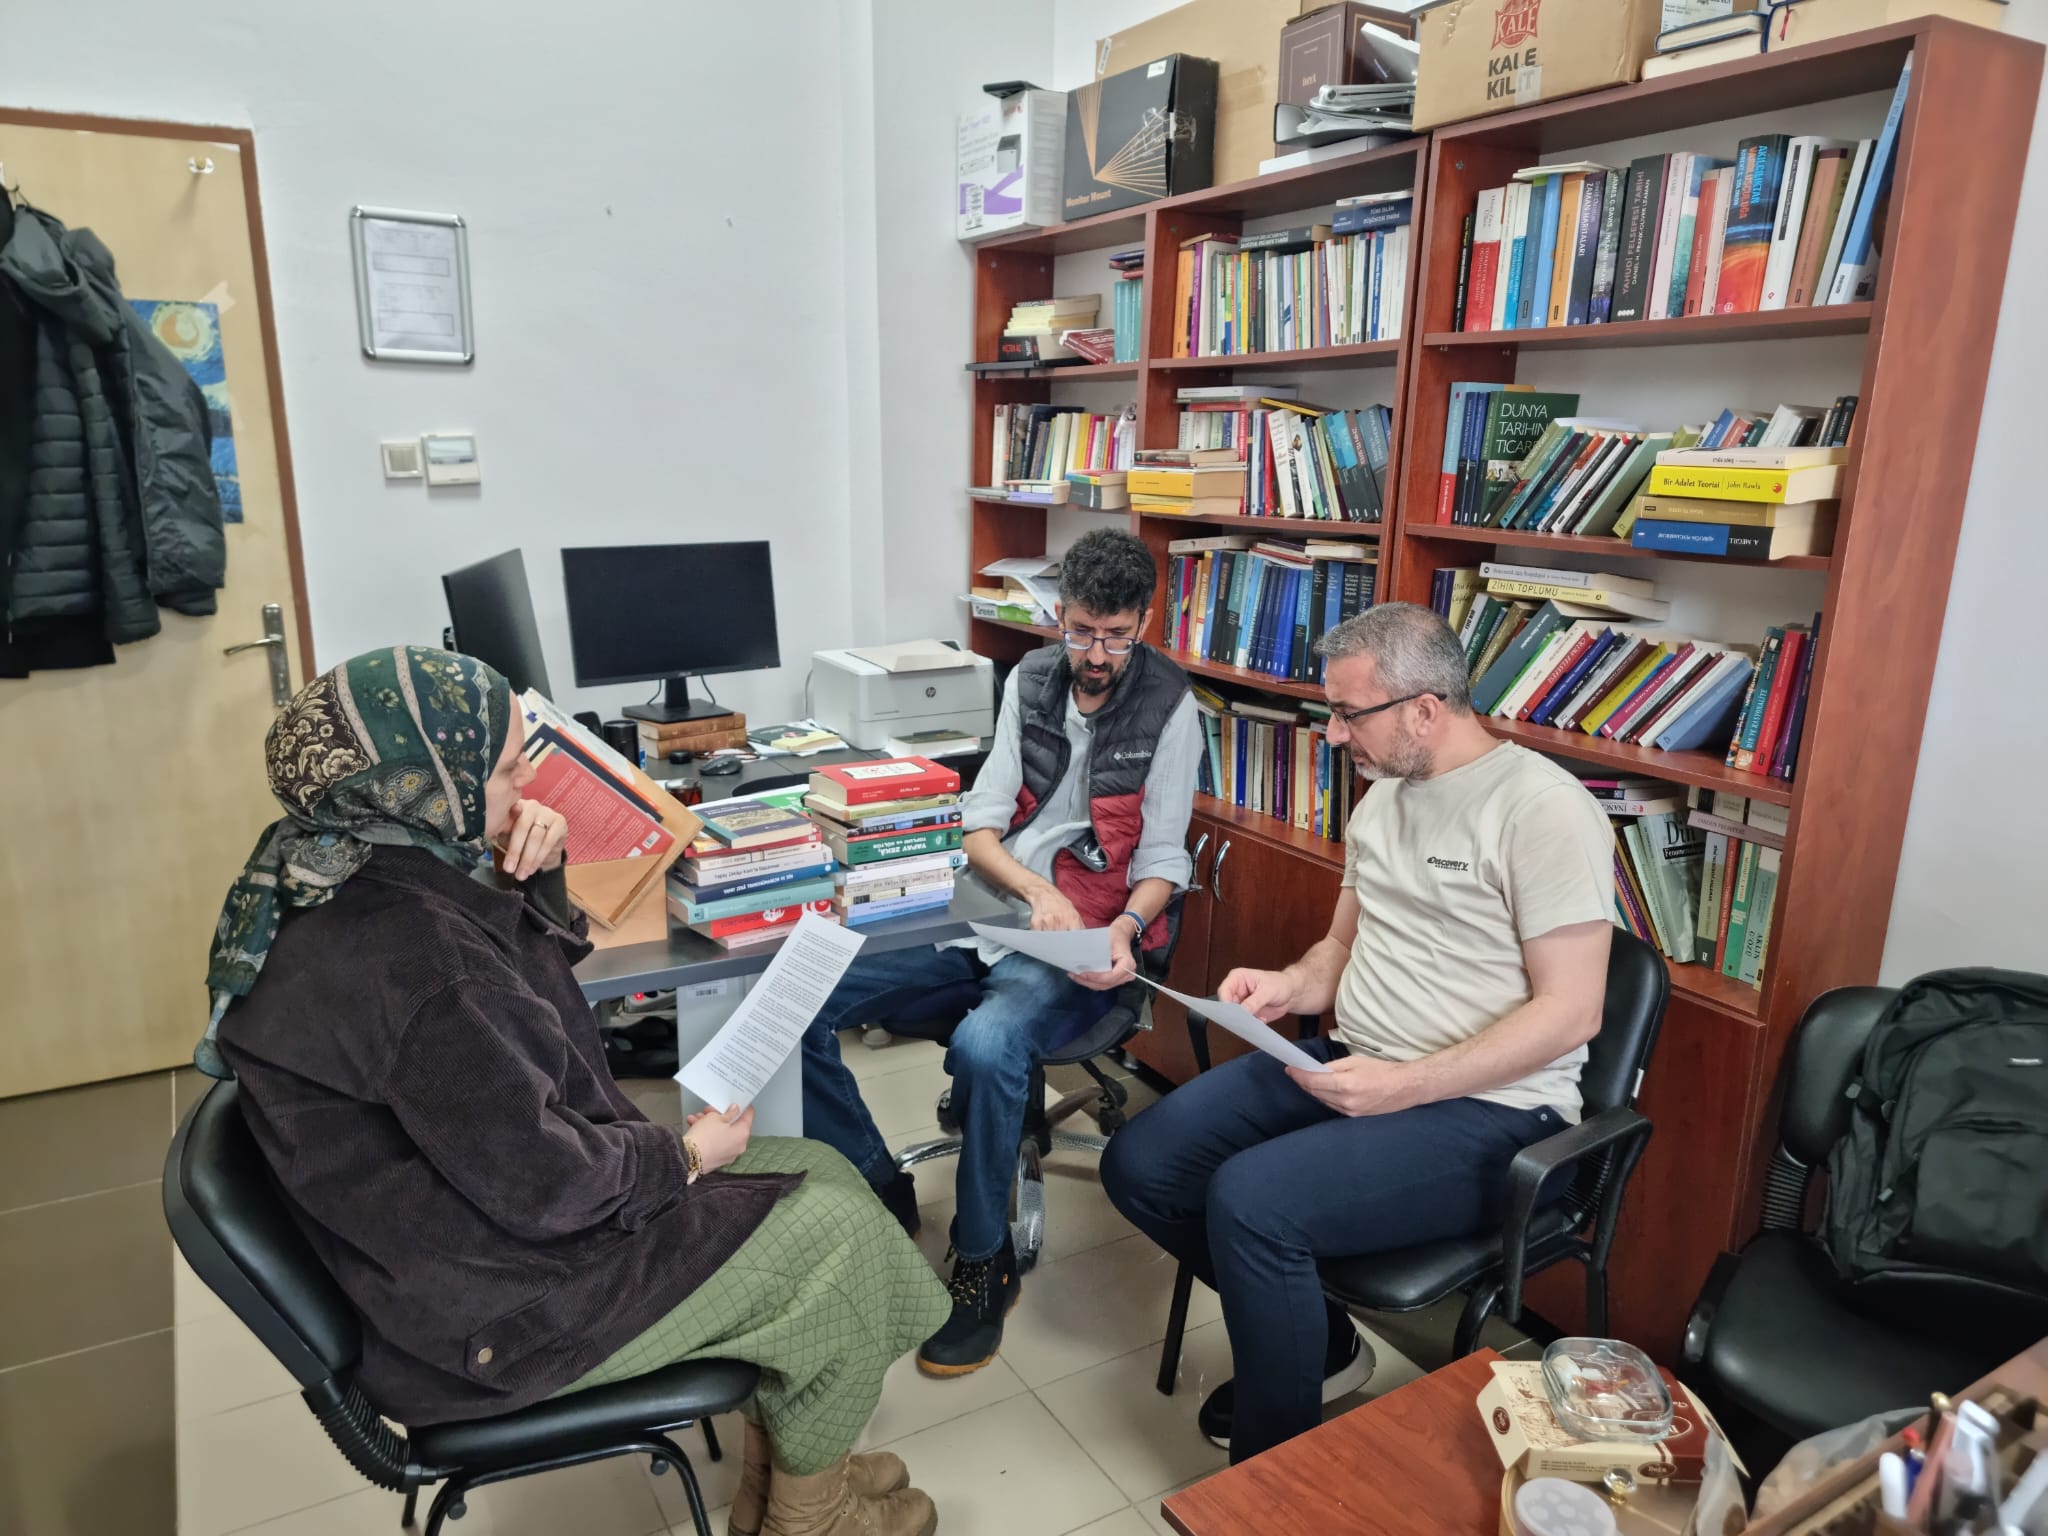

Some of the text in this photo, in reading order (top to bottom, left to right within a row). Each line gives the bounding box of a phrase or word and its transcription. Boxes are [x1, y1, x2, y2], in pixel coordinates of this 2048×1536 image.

[1496, 14, 1537, 38] KALE
[1489, 48, 1536, 77] KALE
[1583, 182, 1592, 212] ZAMAN
[1626, 206, 1639, 255] FELSEFESİ
[1622, 257, 1633, 295] YAHUDİ
[1663, 478, 1673, 487] Bir
[1674, 478, 1696, 488] Adalet
[1727, 480, 1739, 491] John
[1518, 583, 1559, 597] TOPLUMU
[1121, 750, 1152, 759] Columbia
[902, 842, 926, 851] YAPAY
